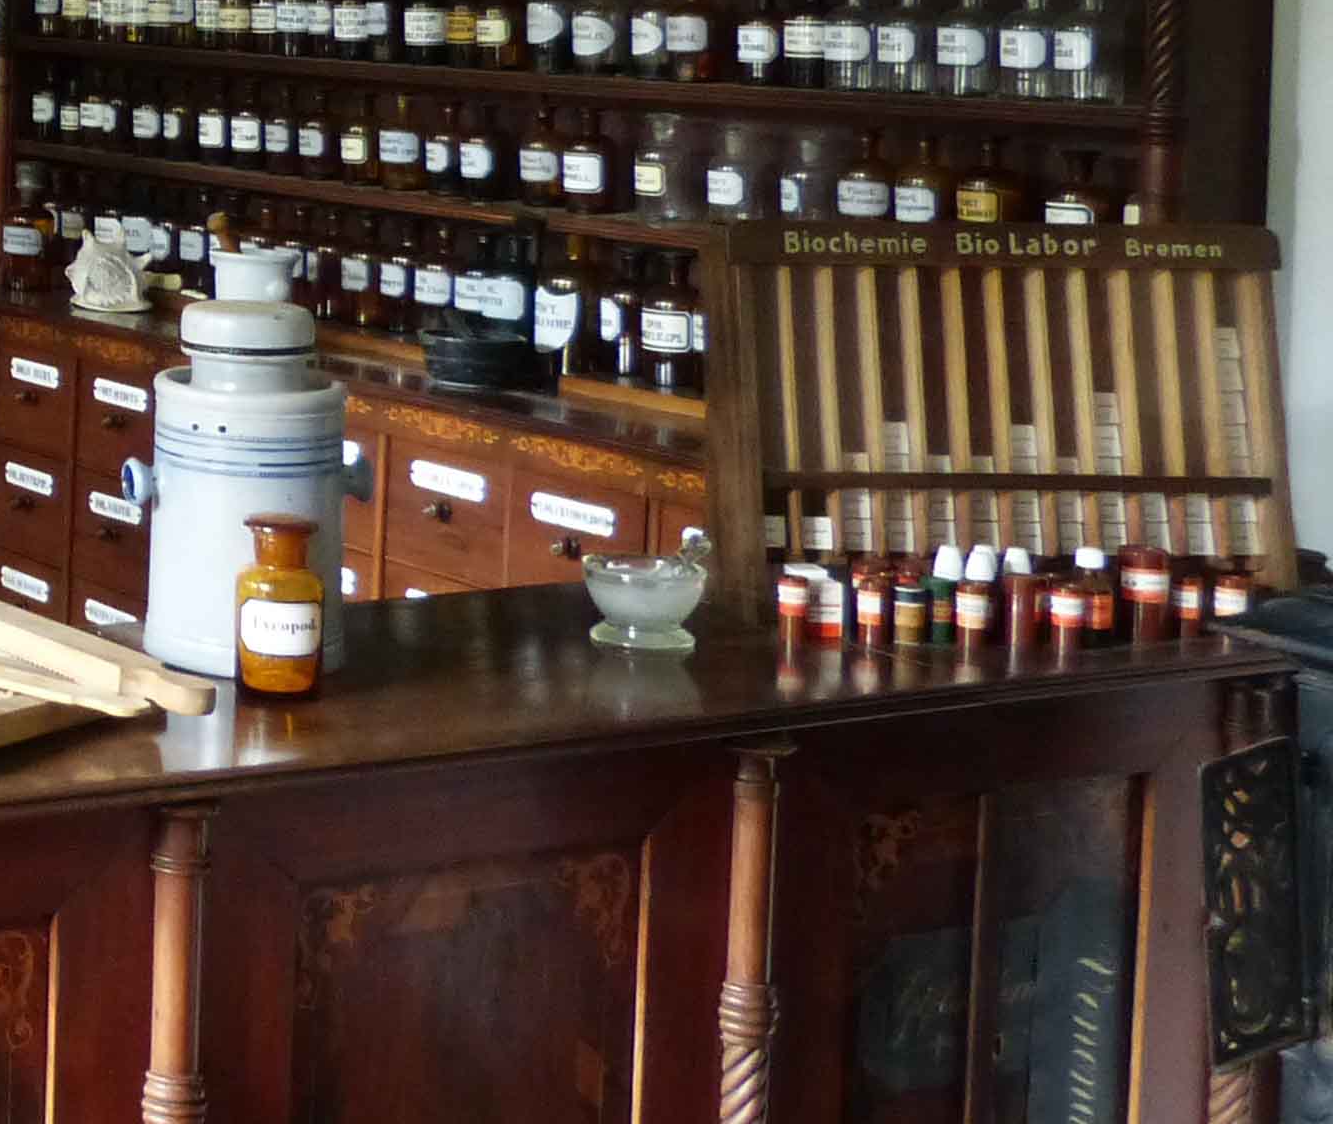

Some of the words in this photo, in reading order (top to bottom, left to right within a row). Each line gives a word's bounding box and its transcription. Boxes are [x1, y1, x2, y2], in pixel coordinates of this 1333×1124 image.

[783, 230, 928, 254] Biochemie
[955, 232, 1001, 255] Bio
[1008, 231, 1098, 257] Labor
[1124, 238, 1223, 259] Bremen
